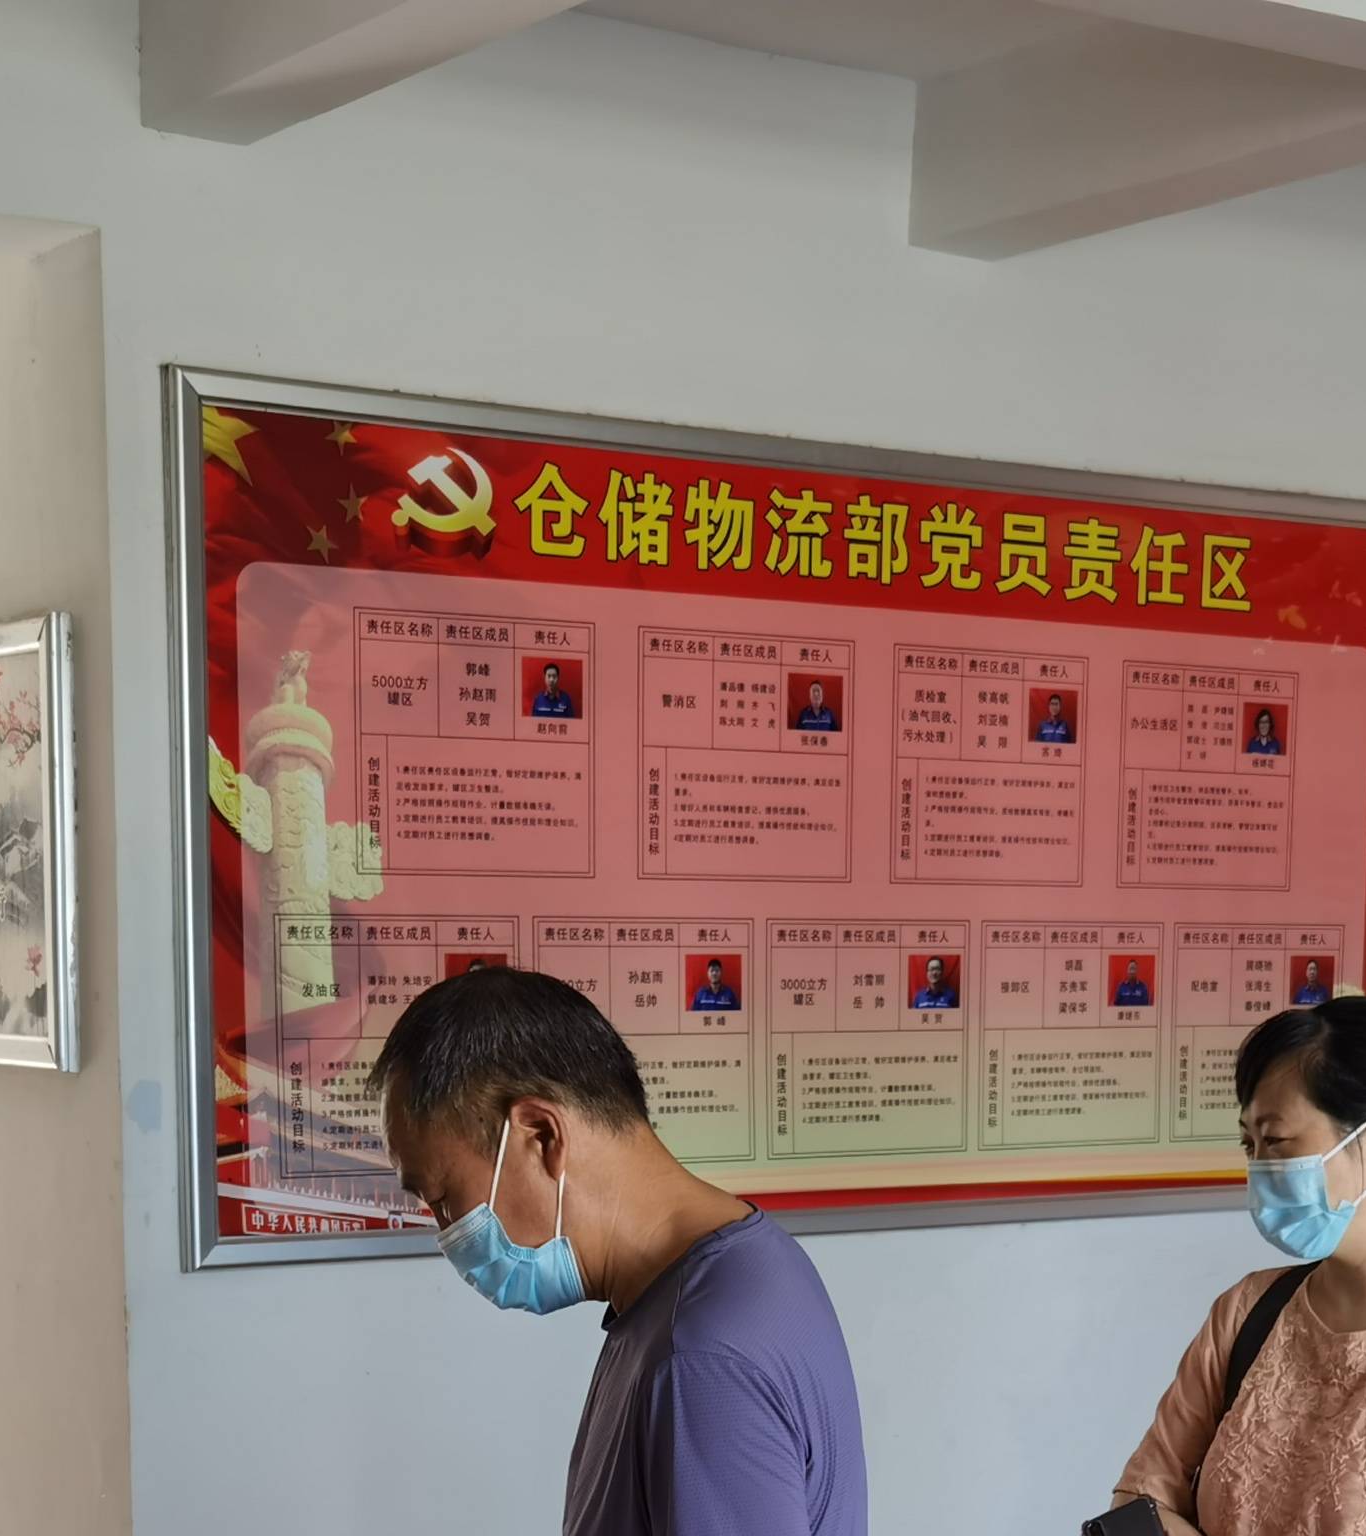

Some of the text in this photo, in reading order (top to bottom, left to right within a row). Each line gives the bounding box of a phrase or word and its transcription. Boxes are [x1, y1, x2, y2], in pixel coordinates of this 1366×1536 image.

[513, 461, 1252, 613] 仓储物流部党员责任区
[366, 619, 570, 647] 责任区名称 责任区成员 责任人
[649, 637, 833, 663] 责任区名称 责任区成员 责任人
[904, 655, 1068, 679] 责任区名称 责任区成员 责任人
[371, 675, 428, 691] 5000立方
[1132, 671, 1280, 692] 责任区名称 责任区成员 责任人
[387, 692, 413, 707] 罐区
[367, 757, 382, 849] 创建活动目标
[648, 768, 660, 856] 创建活动目标
[287, 926, 495, 941] 责任区名称 责任区成员 责任人
[545, 927, 731, 942] 责任区名称 责任区成员 责任人
[777, 930, 949, 943] 责任区名称 责任区成员 责任人
[991, 931, 1145, 944] 责任区名称 责任区成员 责任人
[1183, 933, 1327, 945] 责任区名称 责任区成员 责任人
[301, 983, 341, 998] 发油区
[780, 978, 827, 992] 3000立方
[793, 993, 815, 1006] 罐区
[777, 1053, 788, 1136] 创建活动目标
[290, 1061, 306, 1154] 创建活动目标
